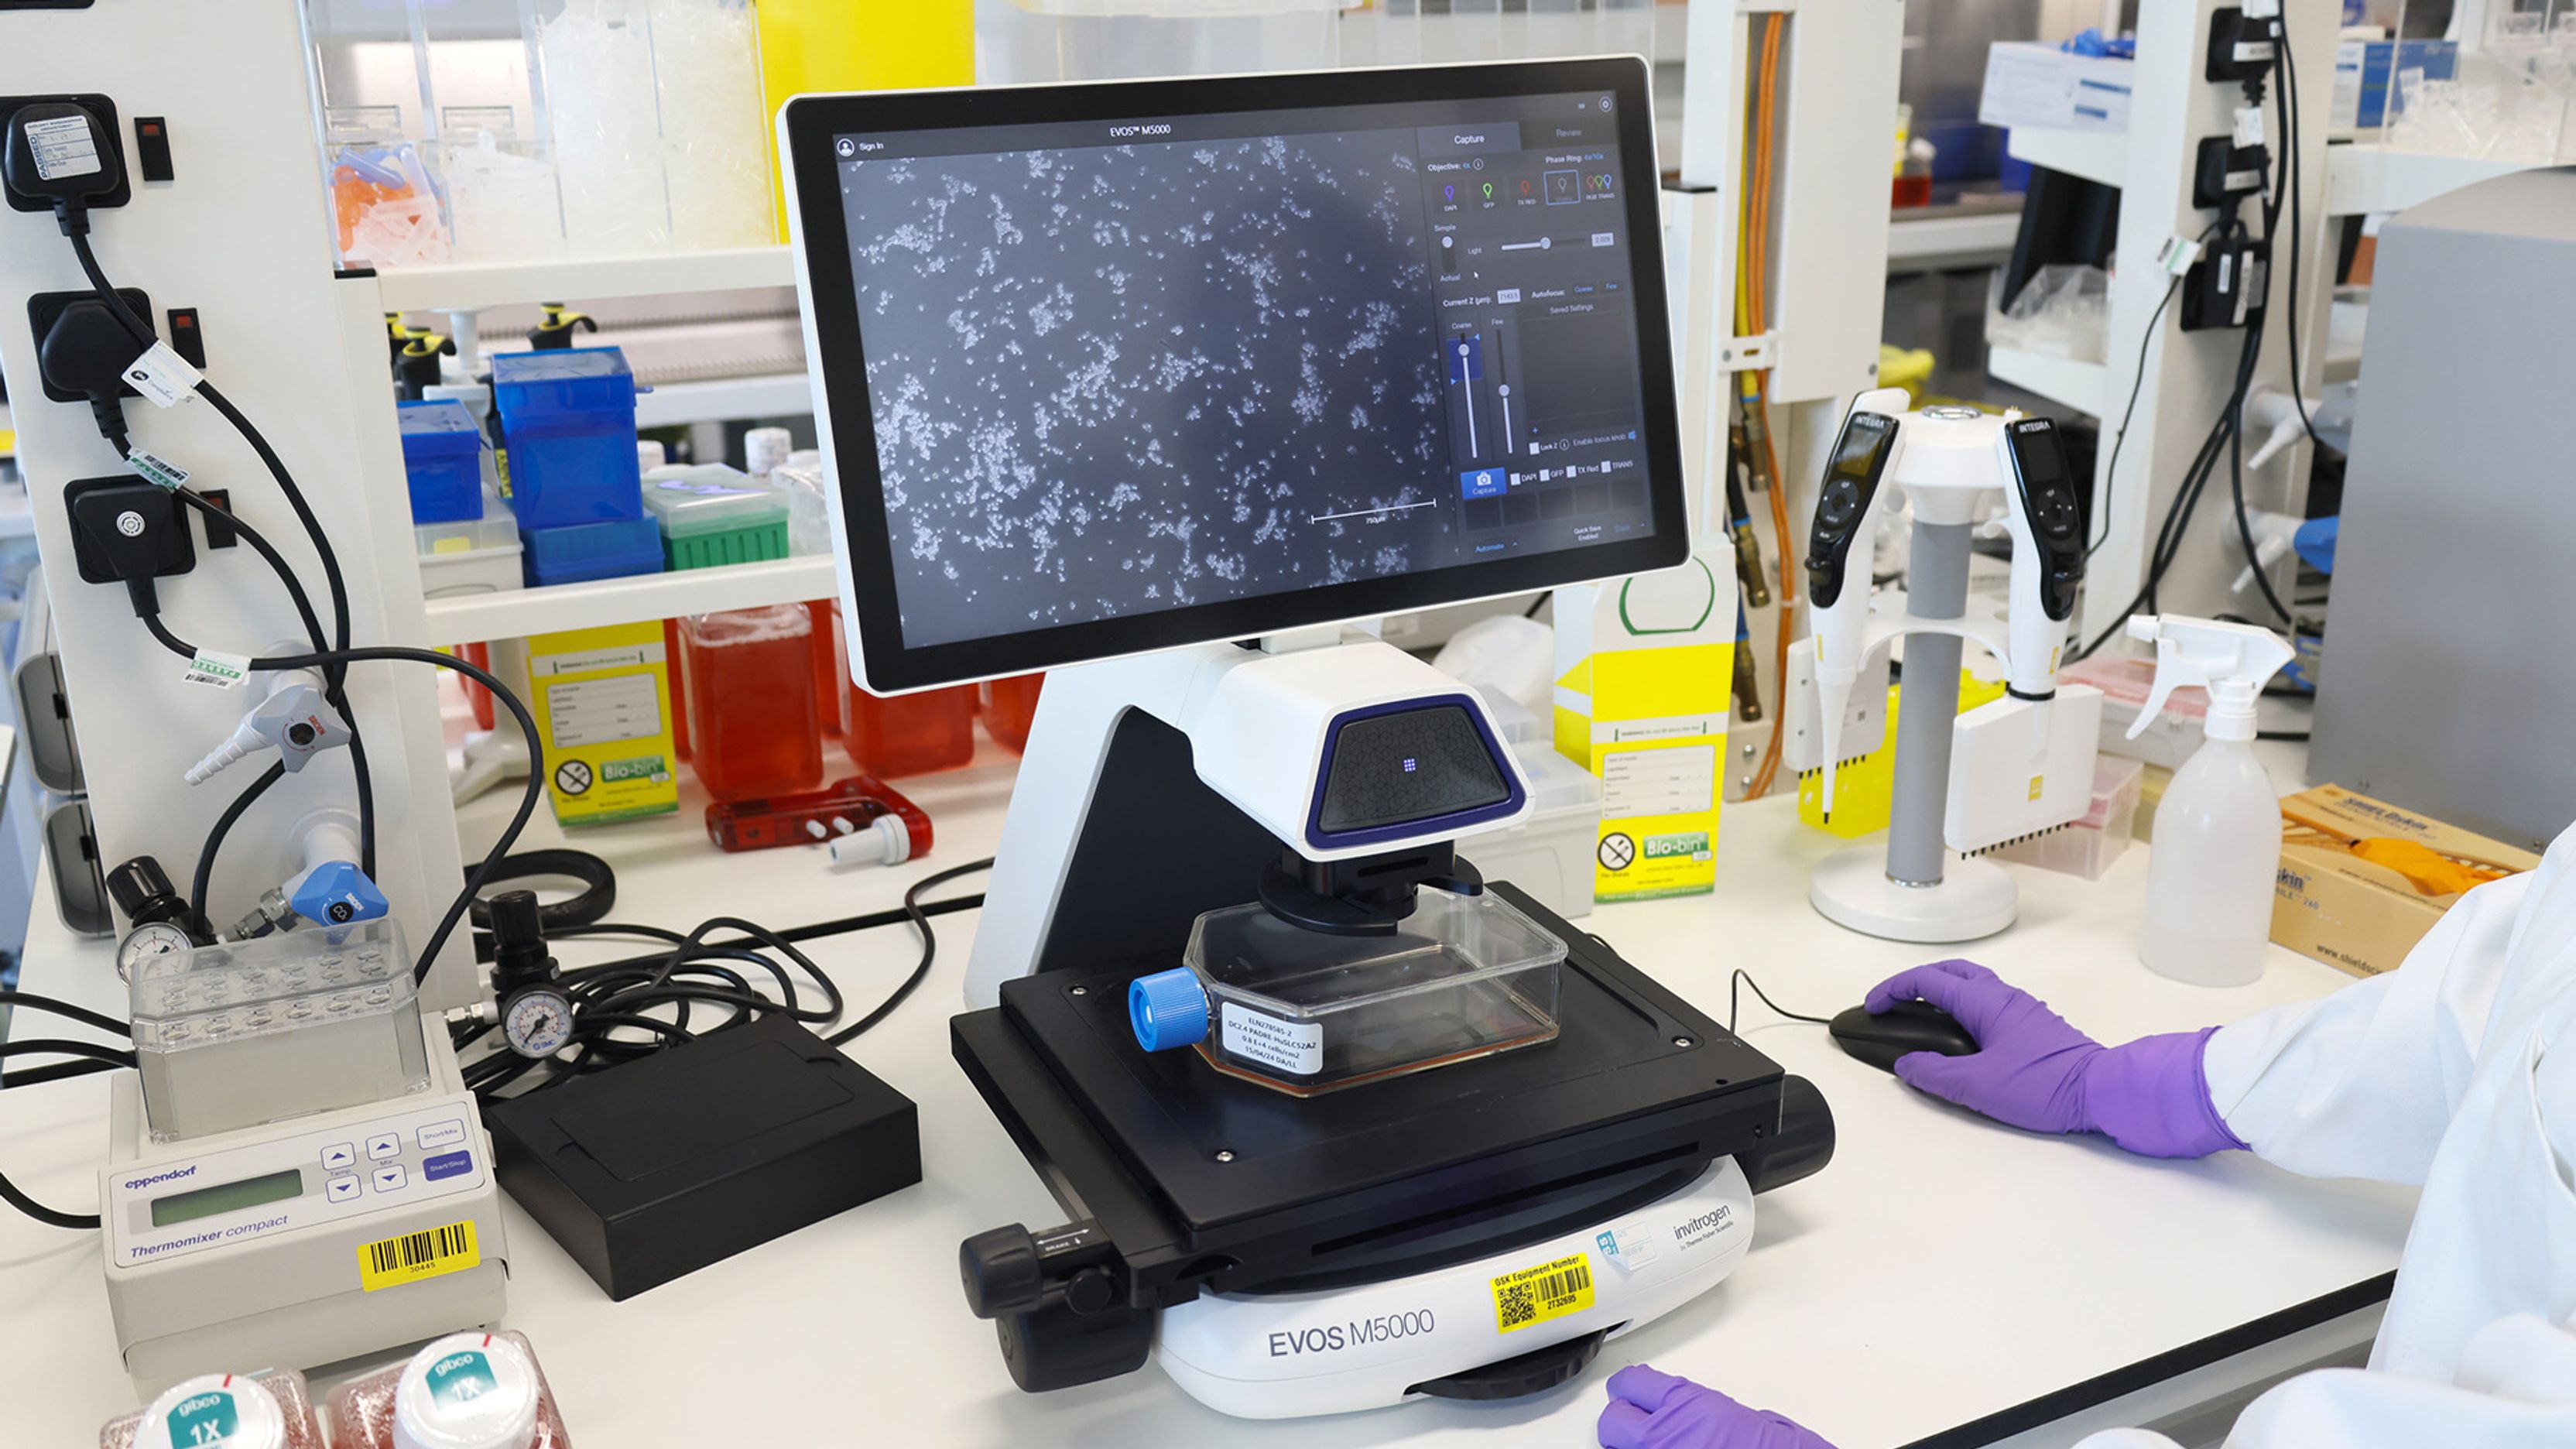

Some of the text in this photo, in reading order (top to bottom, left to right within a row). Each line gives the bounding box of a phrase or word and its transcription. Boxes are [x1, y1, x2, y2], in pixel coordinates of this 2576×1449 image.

[1142, 124, 1171, 135] M5000
[1556, 128, 1583, 137] Review
[1454, 135, 1485, 145] Capture
[859, 142, 876, 152] Sign
[1468, 247, 1482, 255] Light
[1440, 273, 1461, 283] Actual
[1442, 297, 1468, 307] Current
[1469, 296, 1475, 305] Z
[1550, 306, 1569, 314] Saved
[1451, 321, 1472, 330] Coarse
[1855, 415, 1885, 429] INTEGRA
[2019, 420, 2051, 433] INTEGRA
[1573, 438, 1593, 447] Enable
[1612, 461, 1633, 469] TRANS
[1472, 487, 1497, 495] Capture
[1475, 543, 1505, 553] Automate
[1228, 1019, 1248, 1033] DC2.4
[1267, 1043, 1300, 1060] cells/cm2
[1276, 1056, 1298, 1069] DA/LL
[430, 1158, 467, 1173] Start/Stop
[125, 1164, 197, 1190] eppendorf
[1673, 1204, 1732, 1241] invitrogen
[130, 1214, 288, 1259] Thermomixer compact
[1685, 1235, 1703, 1249] Thermo
[1702, 1229, 1716, 1241] Fisher
[1715, 1220, 1735, 1234] Scientific
[1494, 1255, 1580, 1287] GSK Equipment Number
[1269, 1308, 1435, 1358] EVOS M5000
[434, 1354, 474, 1377] gibco
[450, 1375, 480, 1402] 1X
[178, 1393, 221, 1418] gibco
[190, 1417, 223, 1445] 1X
